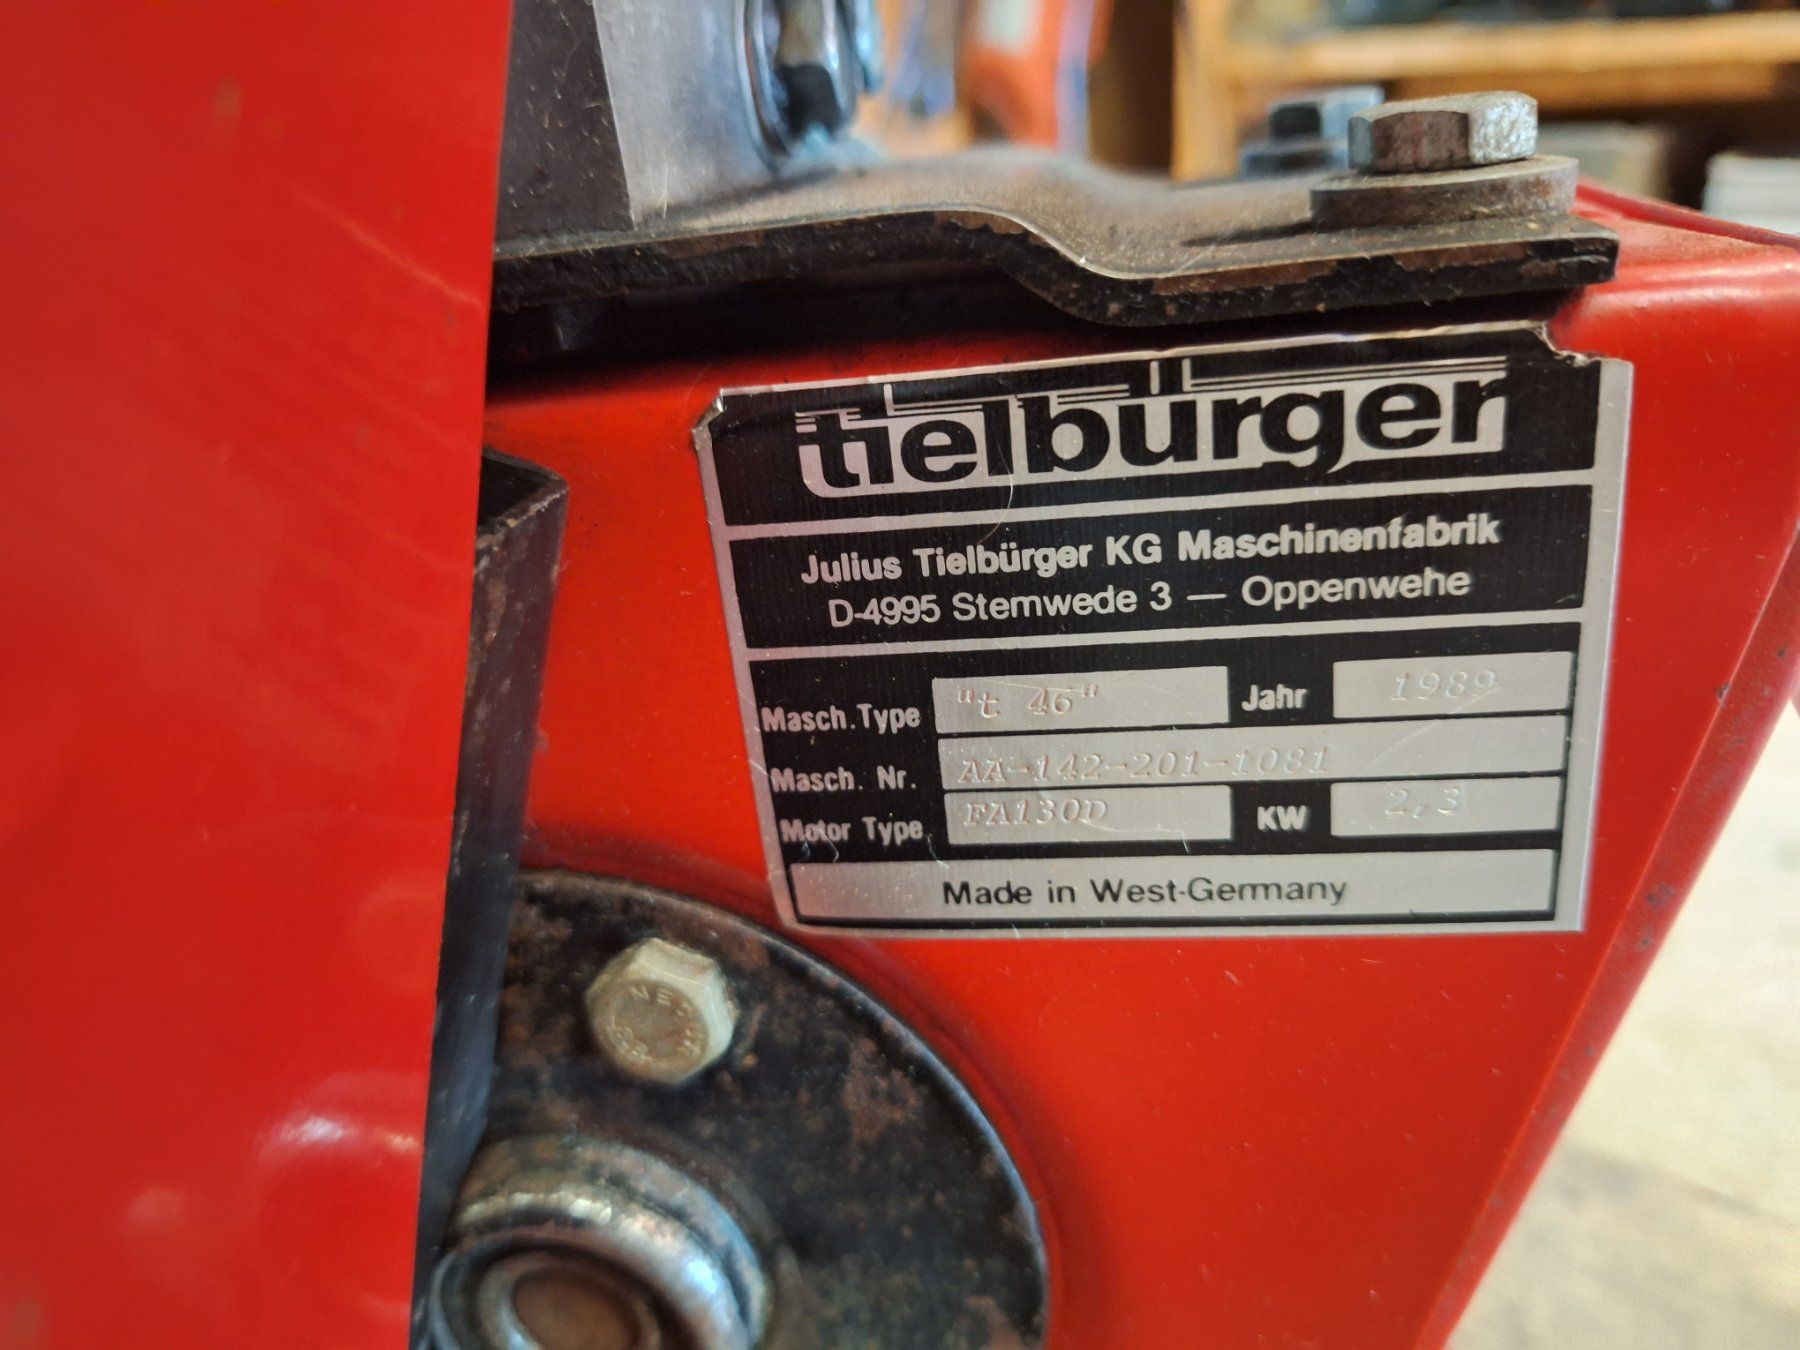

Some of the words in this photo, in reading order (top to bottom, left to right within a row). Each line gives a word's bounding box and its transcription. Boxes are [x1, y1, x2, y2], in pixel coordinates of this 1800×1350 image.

[801, 550, 903, 585] Julius
[912, 542, 1094, 579] Tielbürger
[1106, 531, 1162, 566] KG
[1177, 512, 1502, 562] Maschinenfabrik
[828, 595, 942, 628] D-4995
[952, 585, 1138, 622] Stemwede
[1150, 581, 1173, 612] 3
[1241, 567, 1473, 612] Oppenwehe
[1242, 684, 1309, 713] Jahr
[1390, 669, 1499, 702] 1989
[769, 766, 865, 793] Masch.
[876, 765, 918, 791] Nr.
[956, 746, 1328, 784] AA-142-201-1081
[1256, 805, 1307, 832] KW
[1384, 787, 1462, 820] 2,3
[780, 819, 852, 843] Motor
[861, 816, 925, 846] Type
[942, 881, 1033, 905] Made
[1047, 879, 1076, 903] in
[1090, 876, 1348, 907] West-Germany
